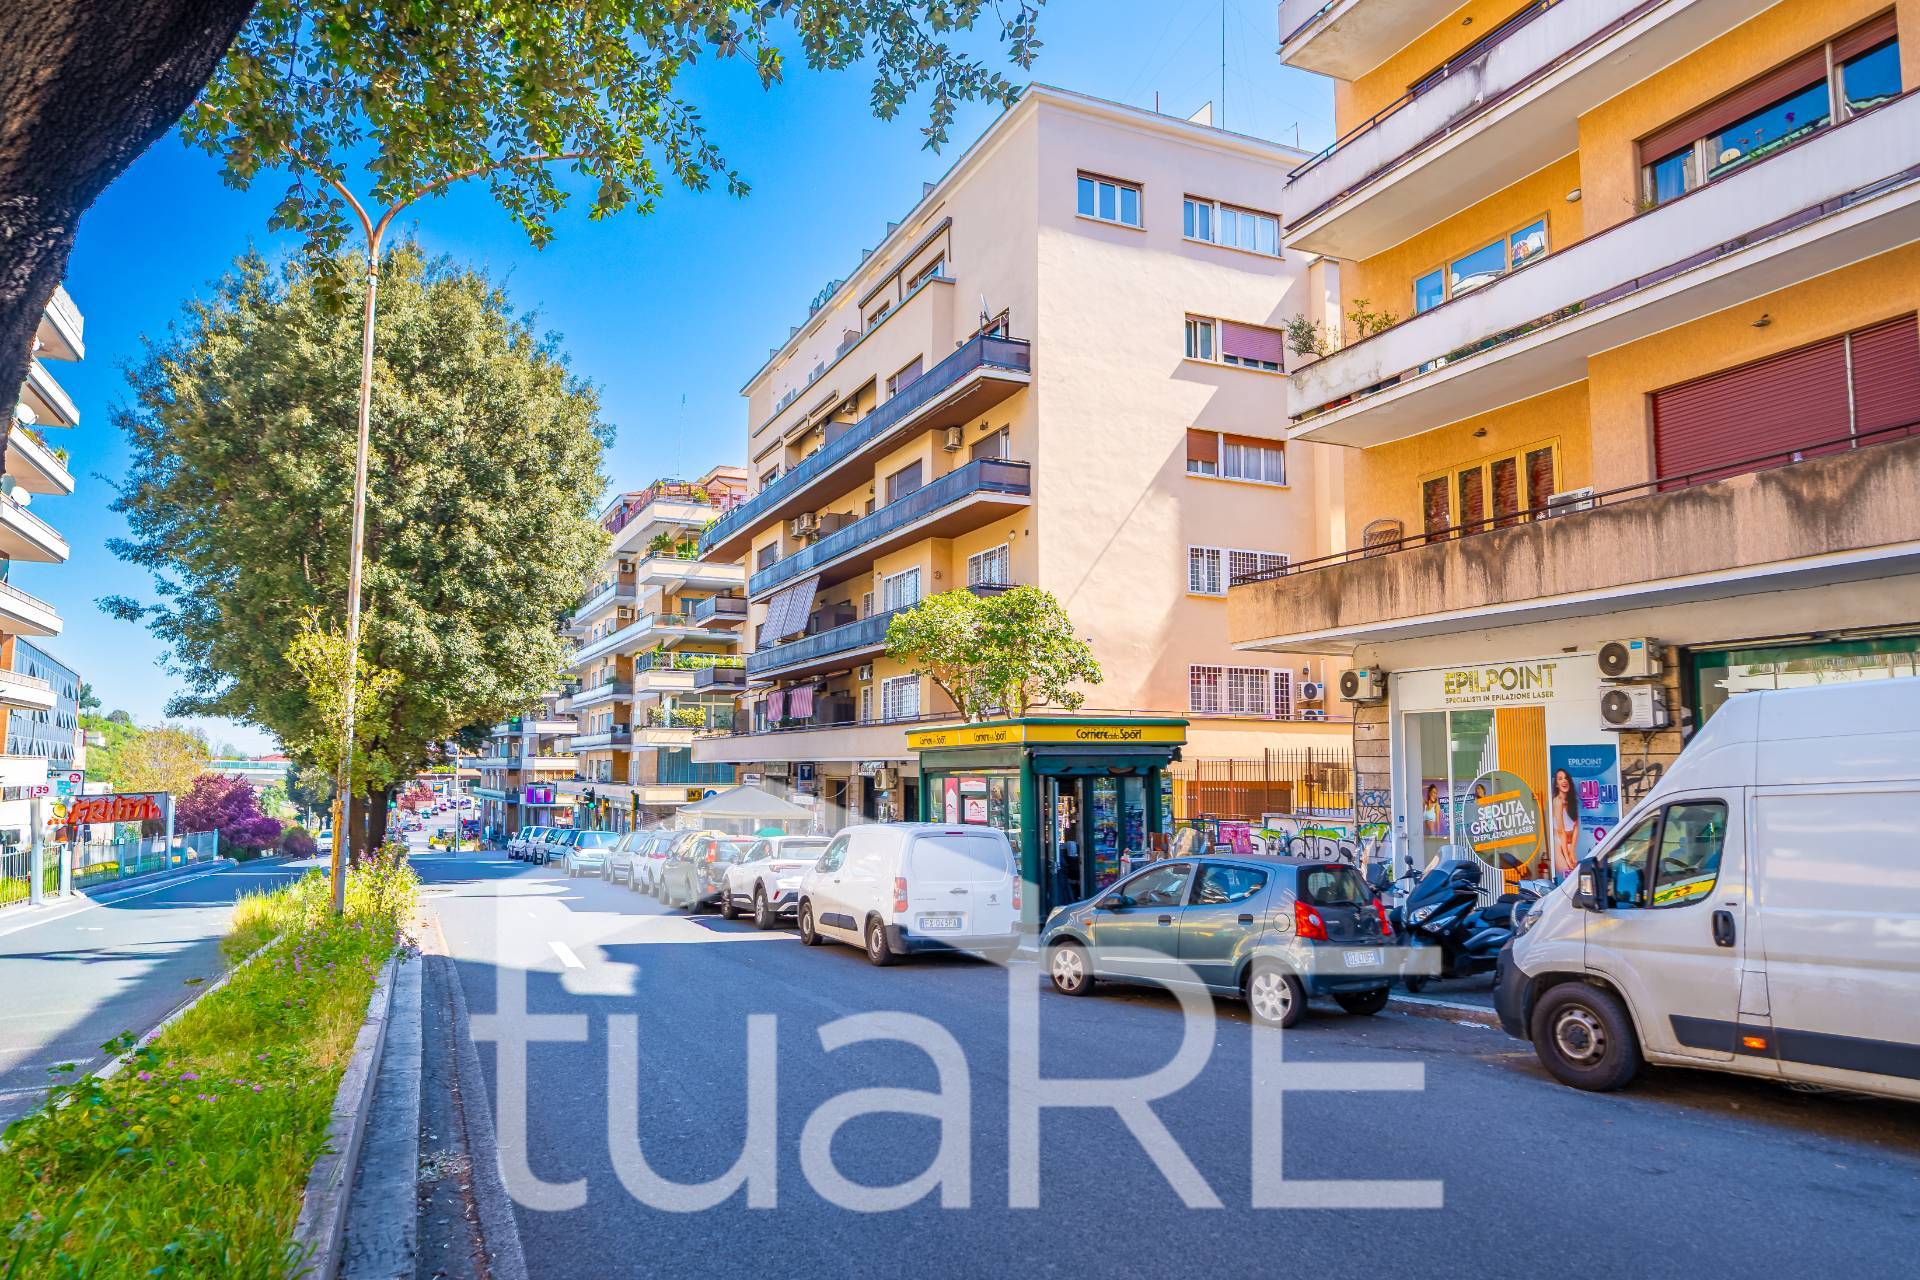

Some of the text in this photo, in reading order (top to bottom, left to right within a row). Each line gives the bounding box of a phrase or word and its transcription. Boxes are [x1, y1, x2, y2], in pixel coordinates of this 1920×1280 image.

[1444, 663, 1557, 694] EPILPOINT
[1445, 690, 1554, 704] SPECIALISTI IN EPILAZIONE LASER
[1568, 758, 1602, 766] EPILPOINT
[1477, 799, 1526, 821] SEDUTA
[1470, 810, 1536, 835] GRATUITA!
[1480, 829, 1514, 841] EPILAZIONE
[1515, 825, 1534, 835] LASER
